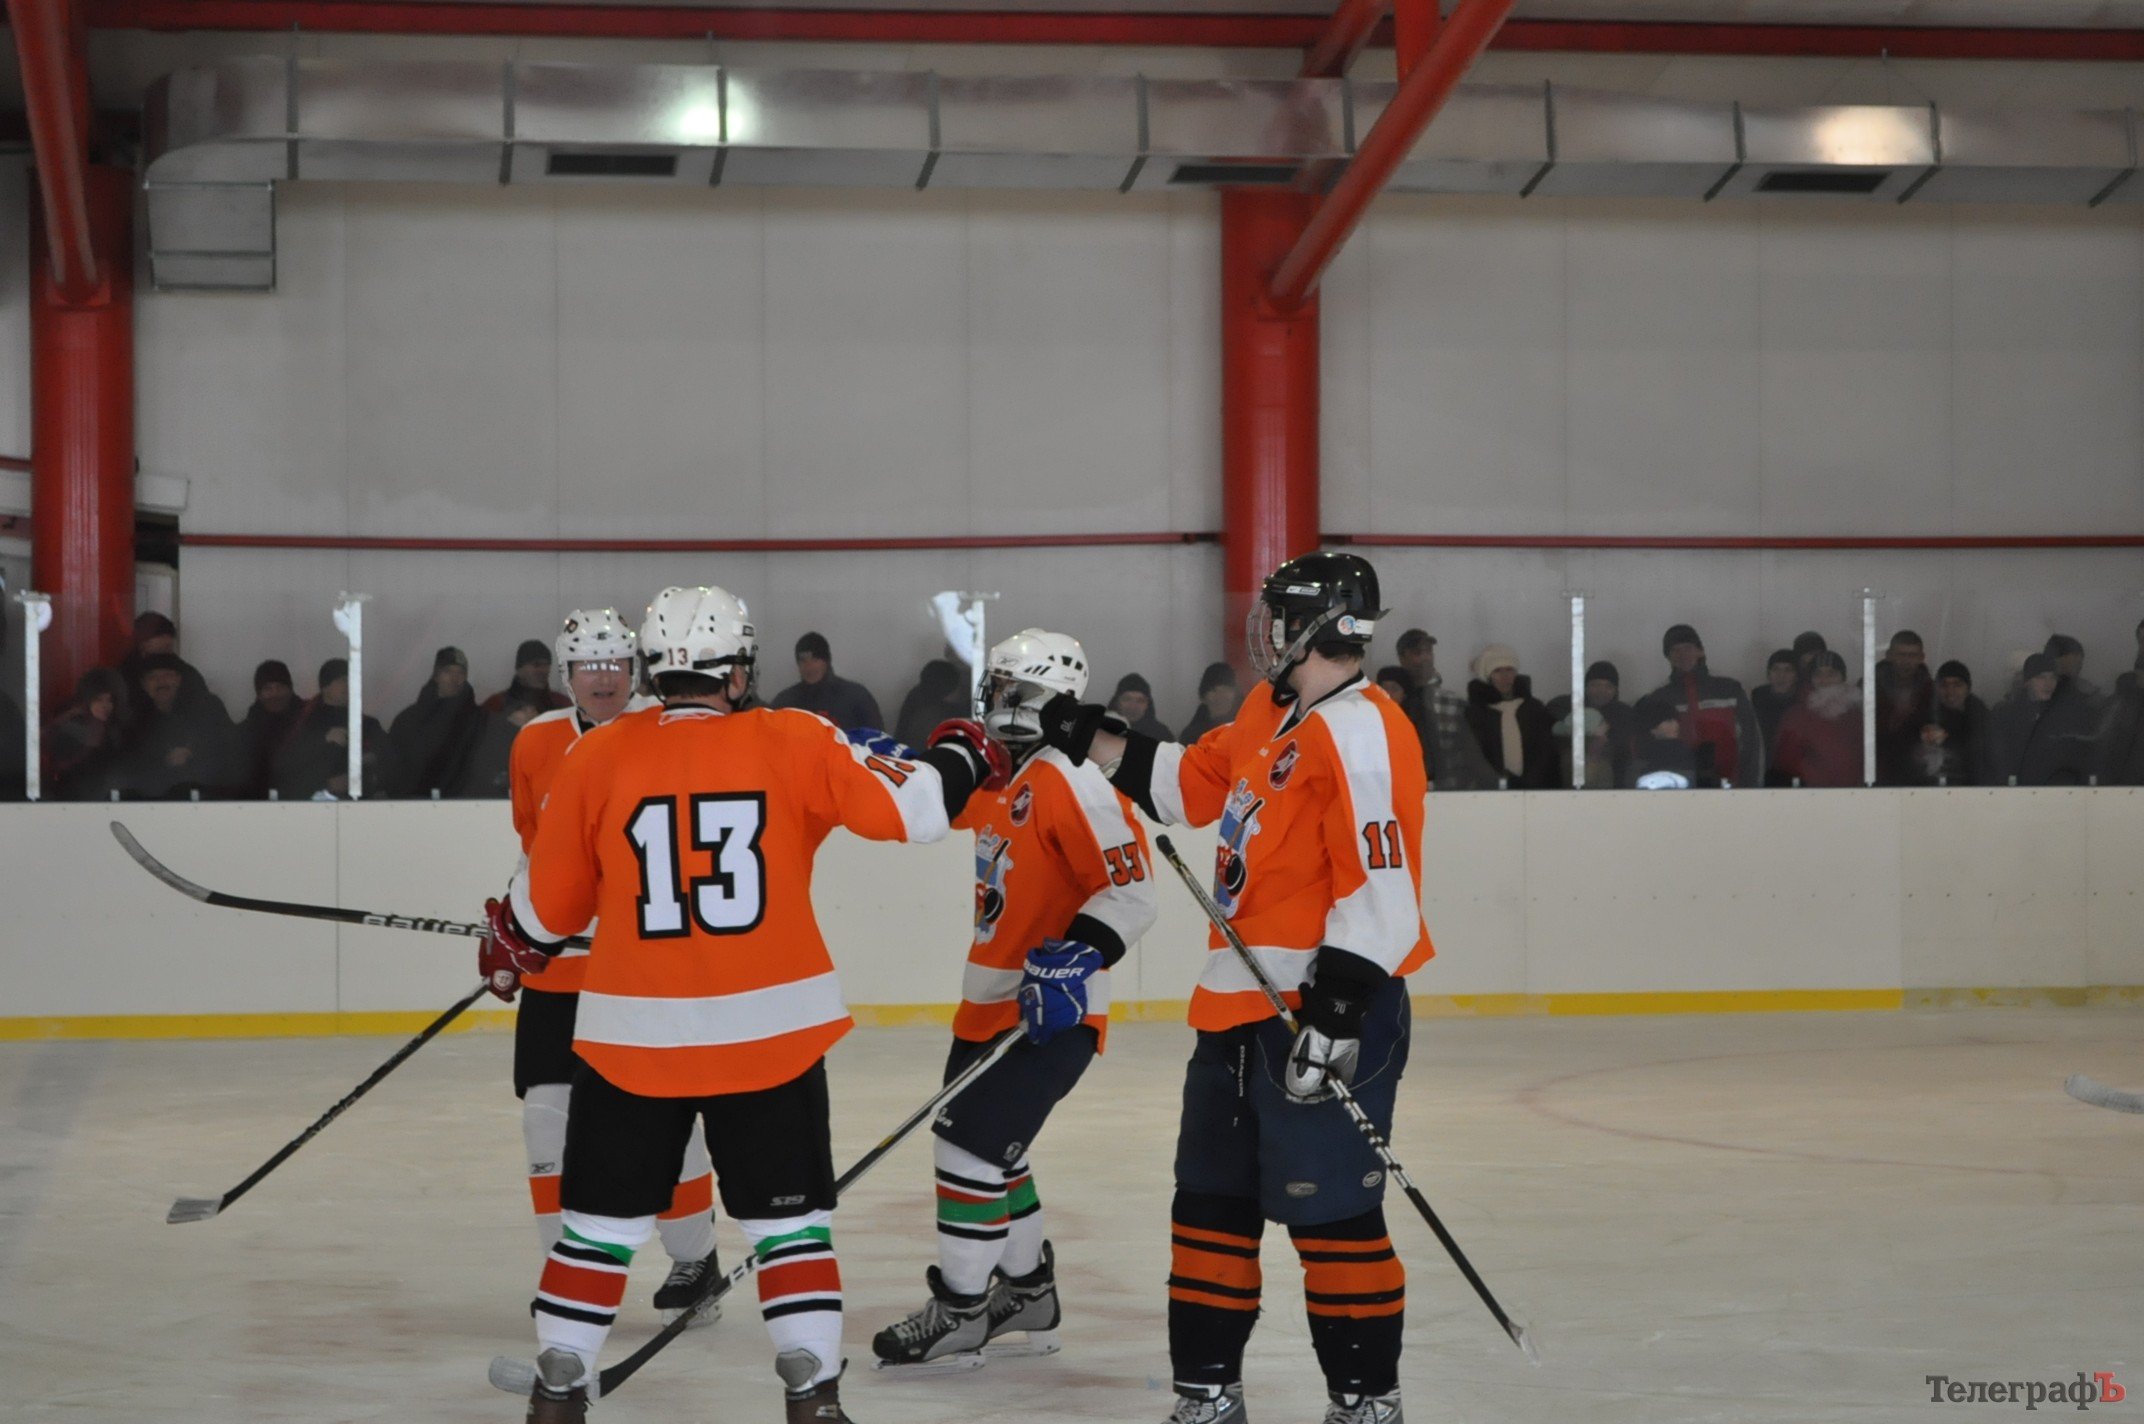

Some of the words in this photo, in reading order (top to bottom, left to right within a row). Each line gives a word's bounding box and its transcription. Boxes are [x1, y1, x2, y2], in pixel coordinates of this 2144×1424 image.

[666, 647, 689, 666] 13
[623, 790, 767, 940] 13
[1103, 841, 1145, 887] 33
[1362, 820, 1402, 869] 11
